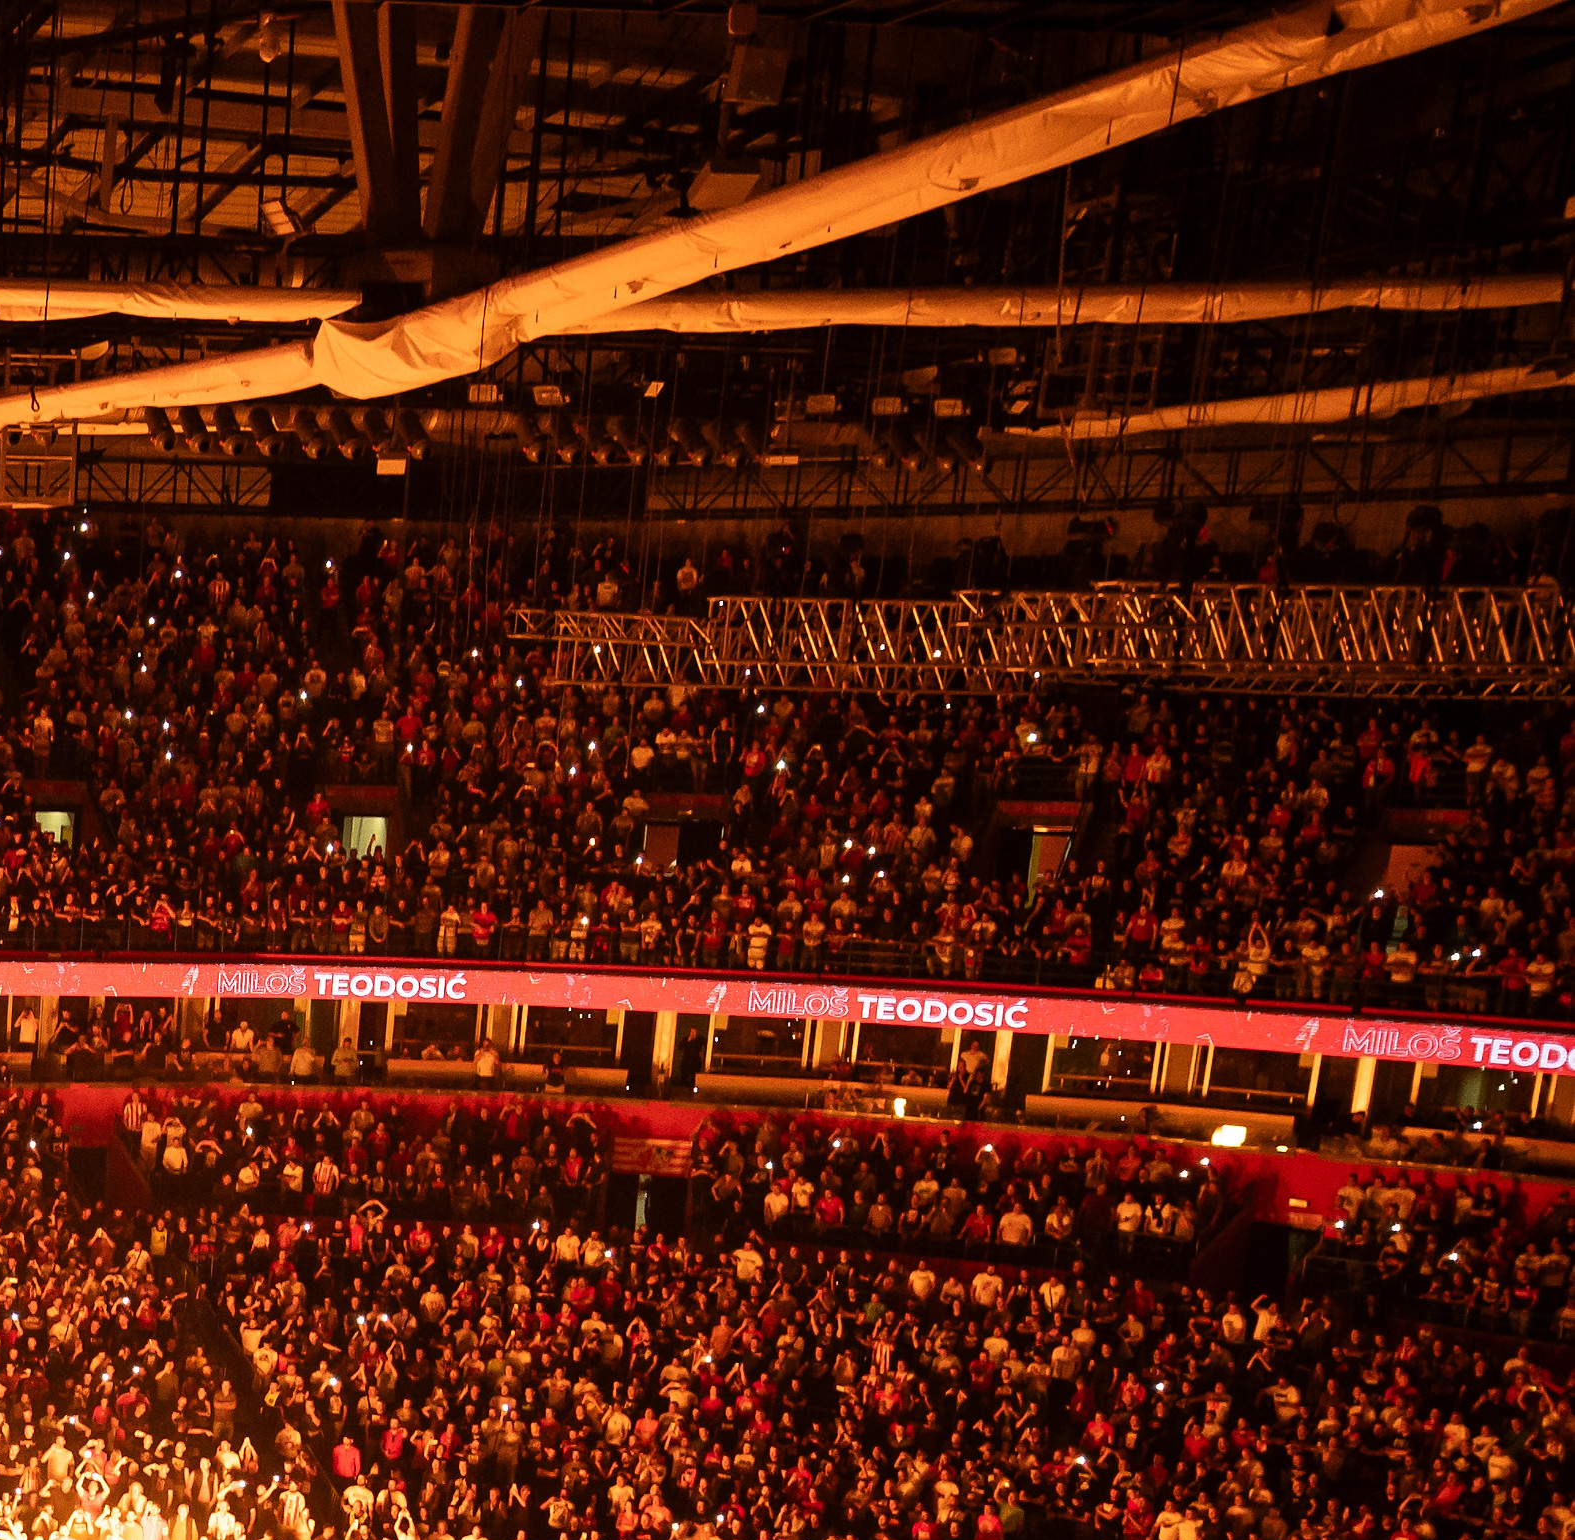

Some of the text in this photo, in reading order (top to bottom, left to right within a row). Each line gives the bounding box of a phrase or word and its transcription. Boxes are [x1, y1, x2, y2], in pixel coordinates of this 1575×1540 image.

[216, 966, 309, 997] MILOŠ
[314, 970, 468, 1002] TEODOSIĆ
[747, 987, 850, 1019] MILOŠ
[857, 993, 1029, 1031] TEODOSIĆ
[1341, 1022, 1464, 1063] MILOŠ
[1470, 1036, 1575, 1072] TEOD
